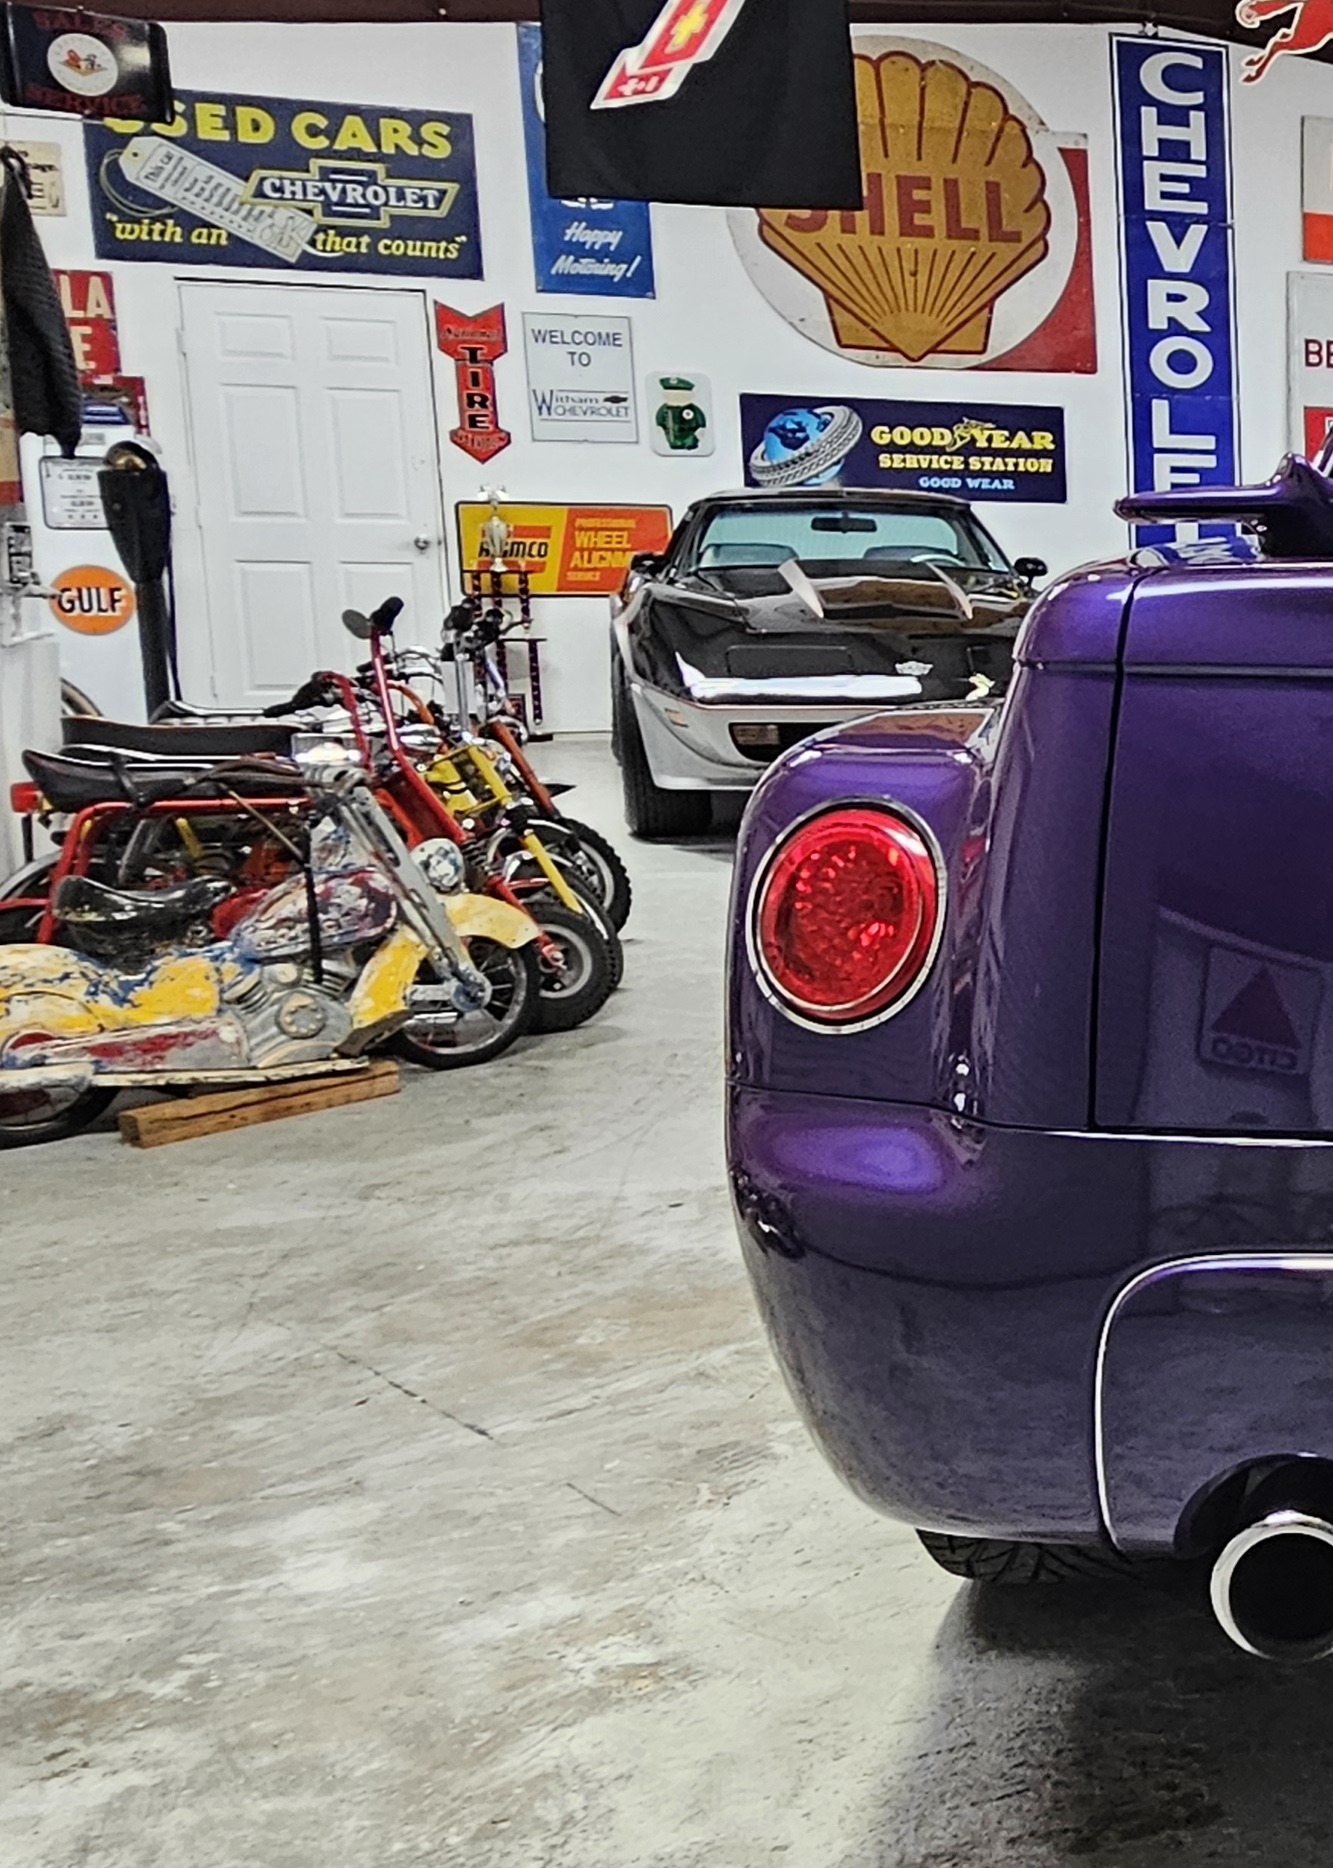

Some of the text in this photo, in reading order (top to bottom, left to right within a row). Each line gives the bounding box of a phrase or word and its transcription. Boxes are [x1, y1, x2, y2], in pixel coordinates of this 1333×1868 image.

[291, 112, 452, 159] CARS
[262, 177, 440, 208] CHEVROLET
[191, 227, 228, 245] an
[314, 230, 371, 254] that
[563, 221, 623, 250] Happy
[551, 255, 642, 282] Motoring!
[531, 328, 623, 348] WELCOME
[567, 351, 592, 367] TO
[458, 345, 491, 430] TIRE
[554, 405, 629, 418] CHEVROLET
[879, 453, 1053, 473] SERVICE STATION
[918, 476, 1015, 490] GOOD WEAR
[574, 531, 632, 549] WHEEL
[57, 587, 122, 616] GULF
